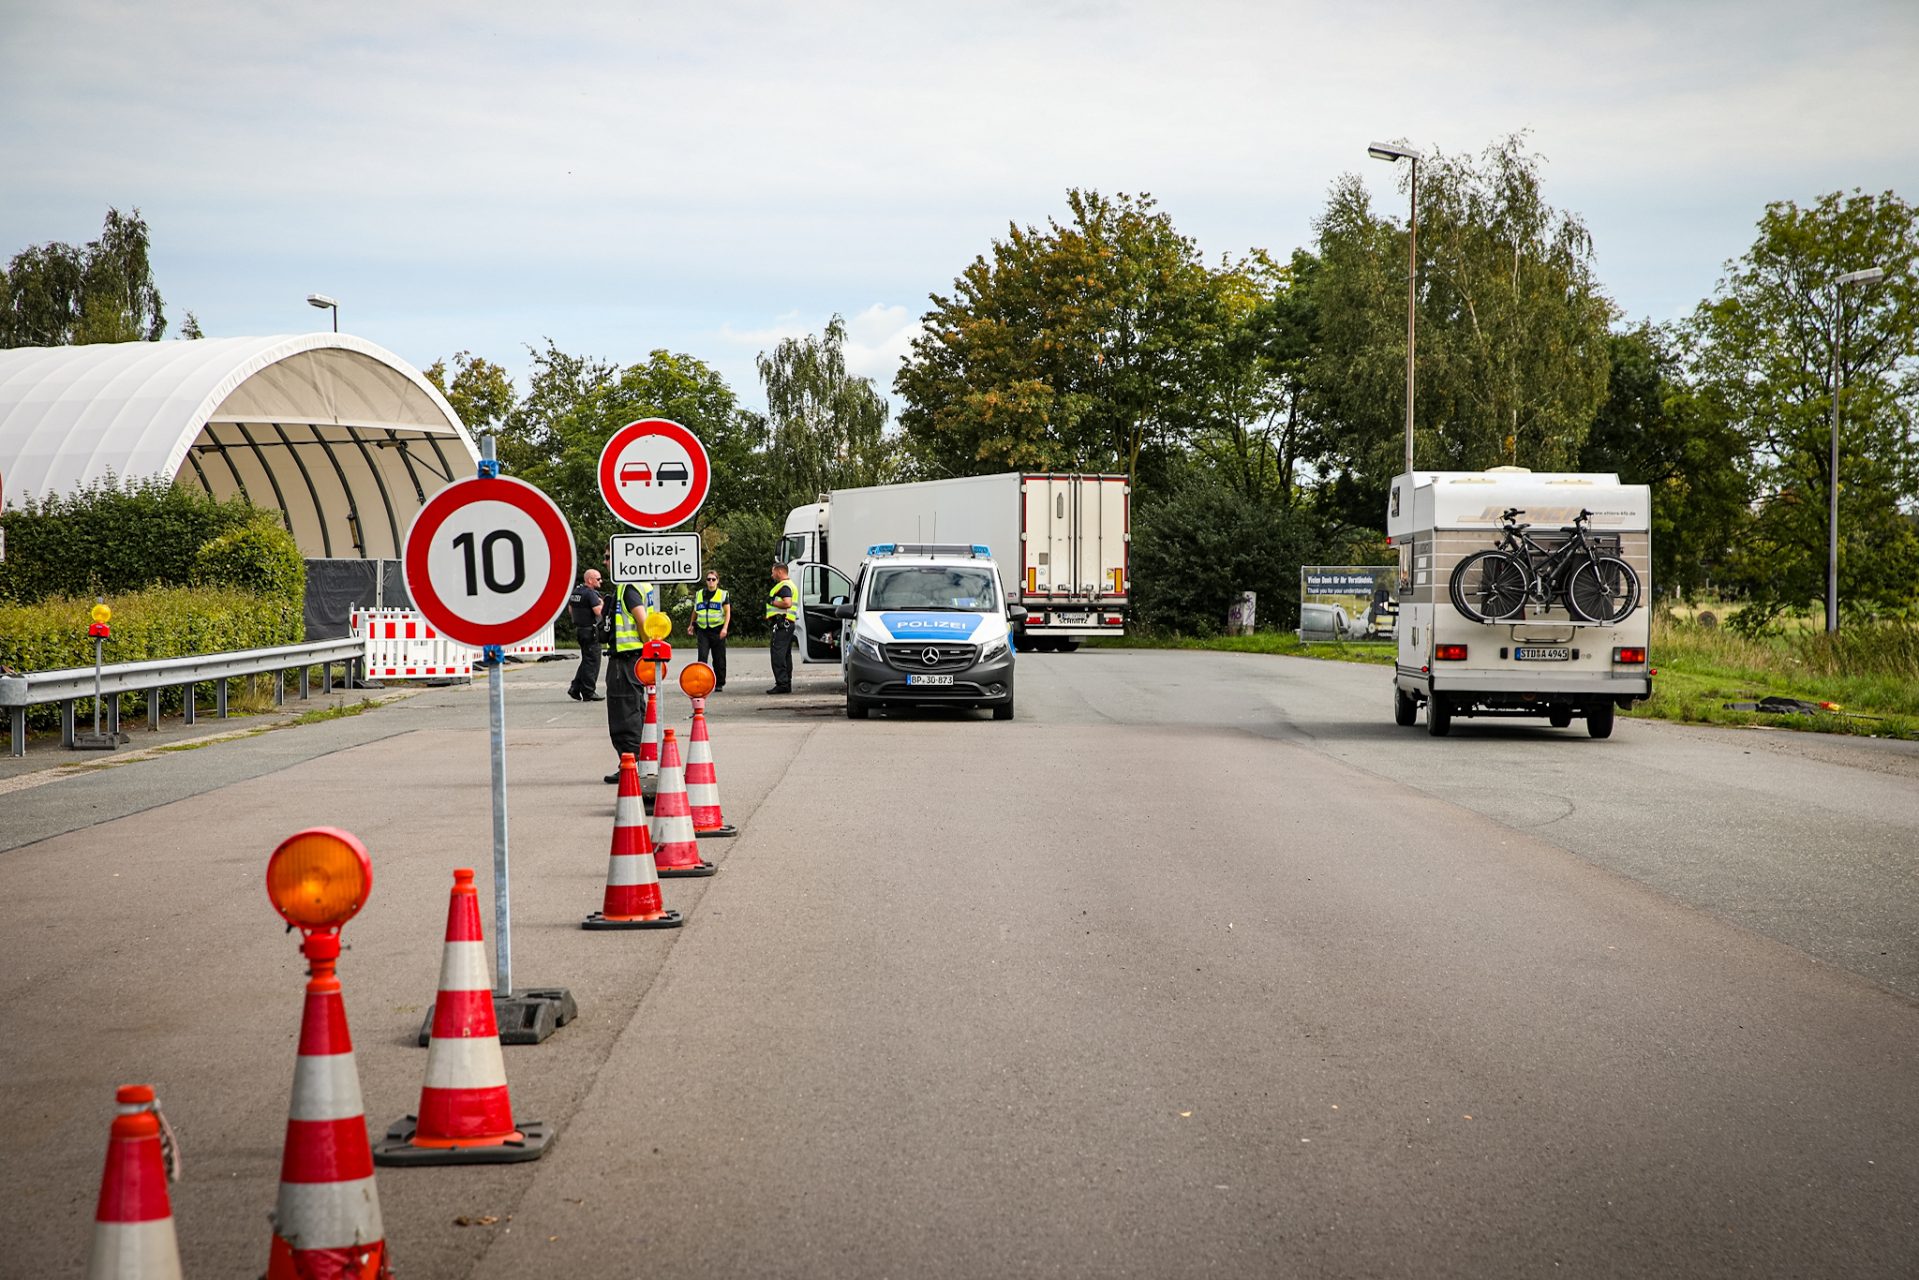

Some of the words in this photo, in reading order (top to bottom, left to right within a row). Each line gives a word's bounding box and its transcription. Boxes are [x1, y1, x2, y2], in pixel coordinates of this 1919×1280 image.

[625, 542, 686, 556] Polizei-
[452, 529, 526, 596] 10
[619, 560, 692, 575] kontrolle
[1307, 576, 1320, 584] Vielen
[1321, 576, 1332, 584] Dank
[897, 621, 966, 630] POLIZEI
[1521, 649, 1536, 658] STD
[1541, 649, 1547, 658] A
[1548, 649, 1568, 658] 4945
[911, 676, 922, 684] BP
